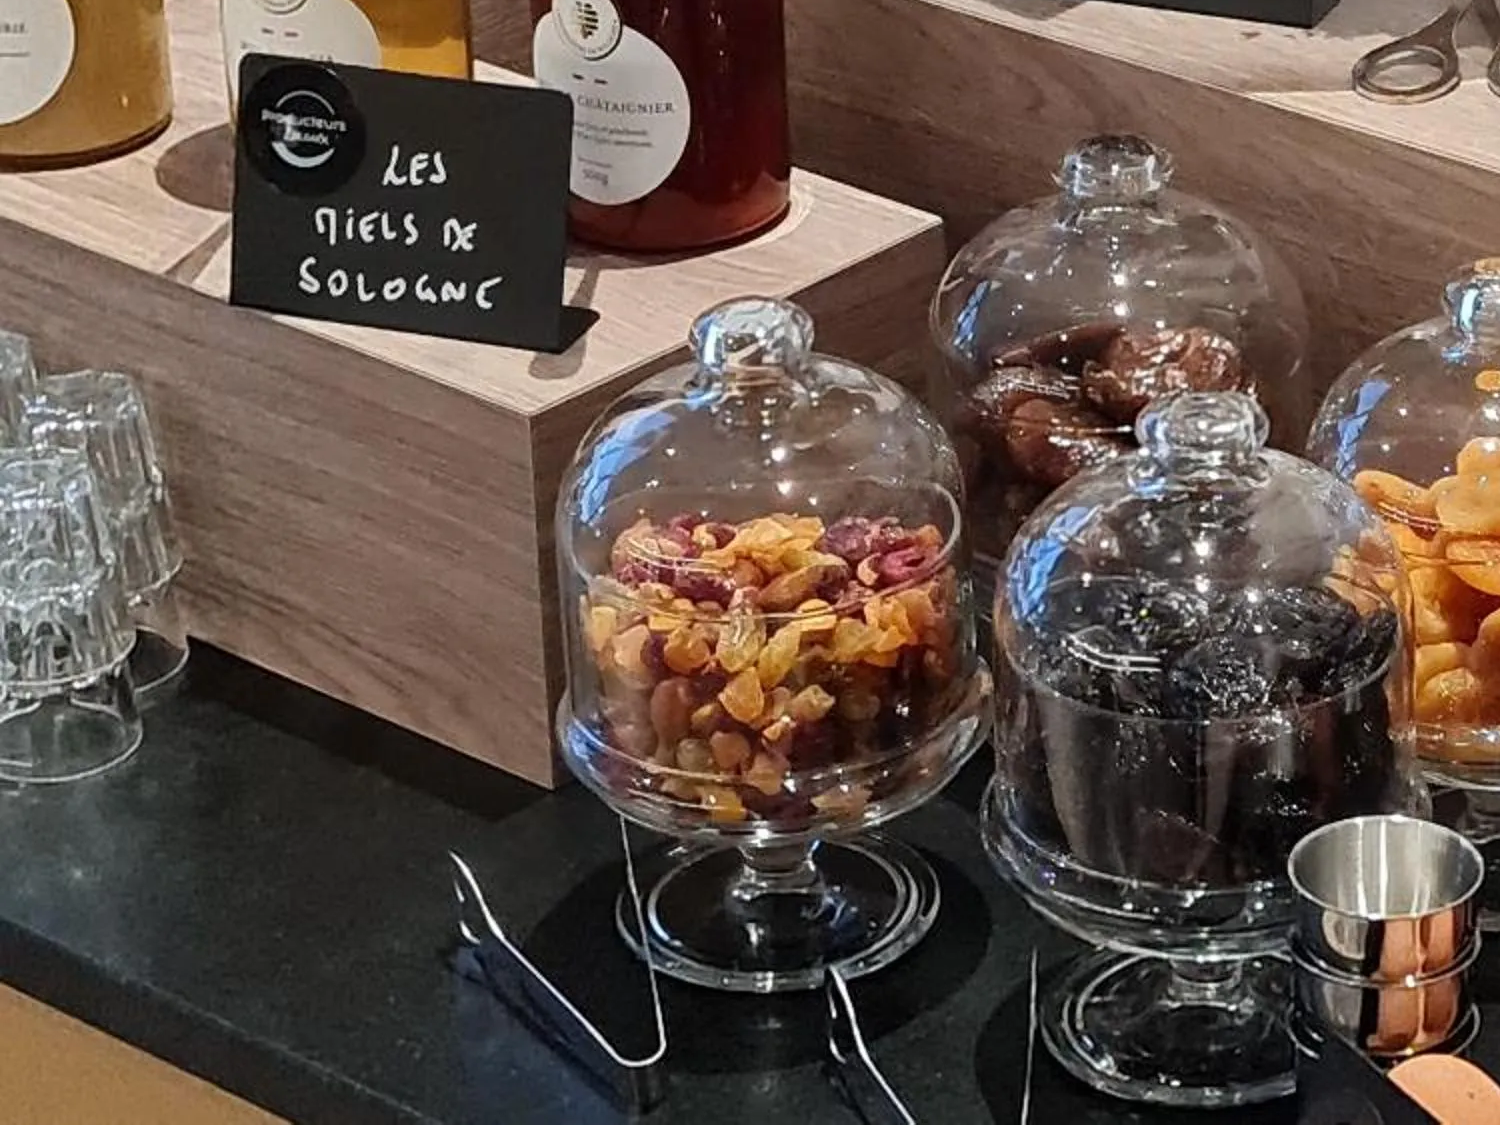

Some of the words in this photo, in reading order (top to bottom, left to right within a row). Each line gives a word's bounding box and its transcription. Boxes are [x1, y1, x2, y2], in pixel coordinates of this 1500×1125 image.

[382, 145, 447, 186] LES
[314, 207, 420, 245] MIELS
[442, 218, 478, 252] DE
[298, 256, 503, 309] SOLOGNE
